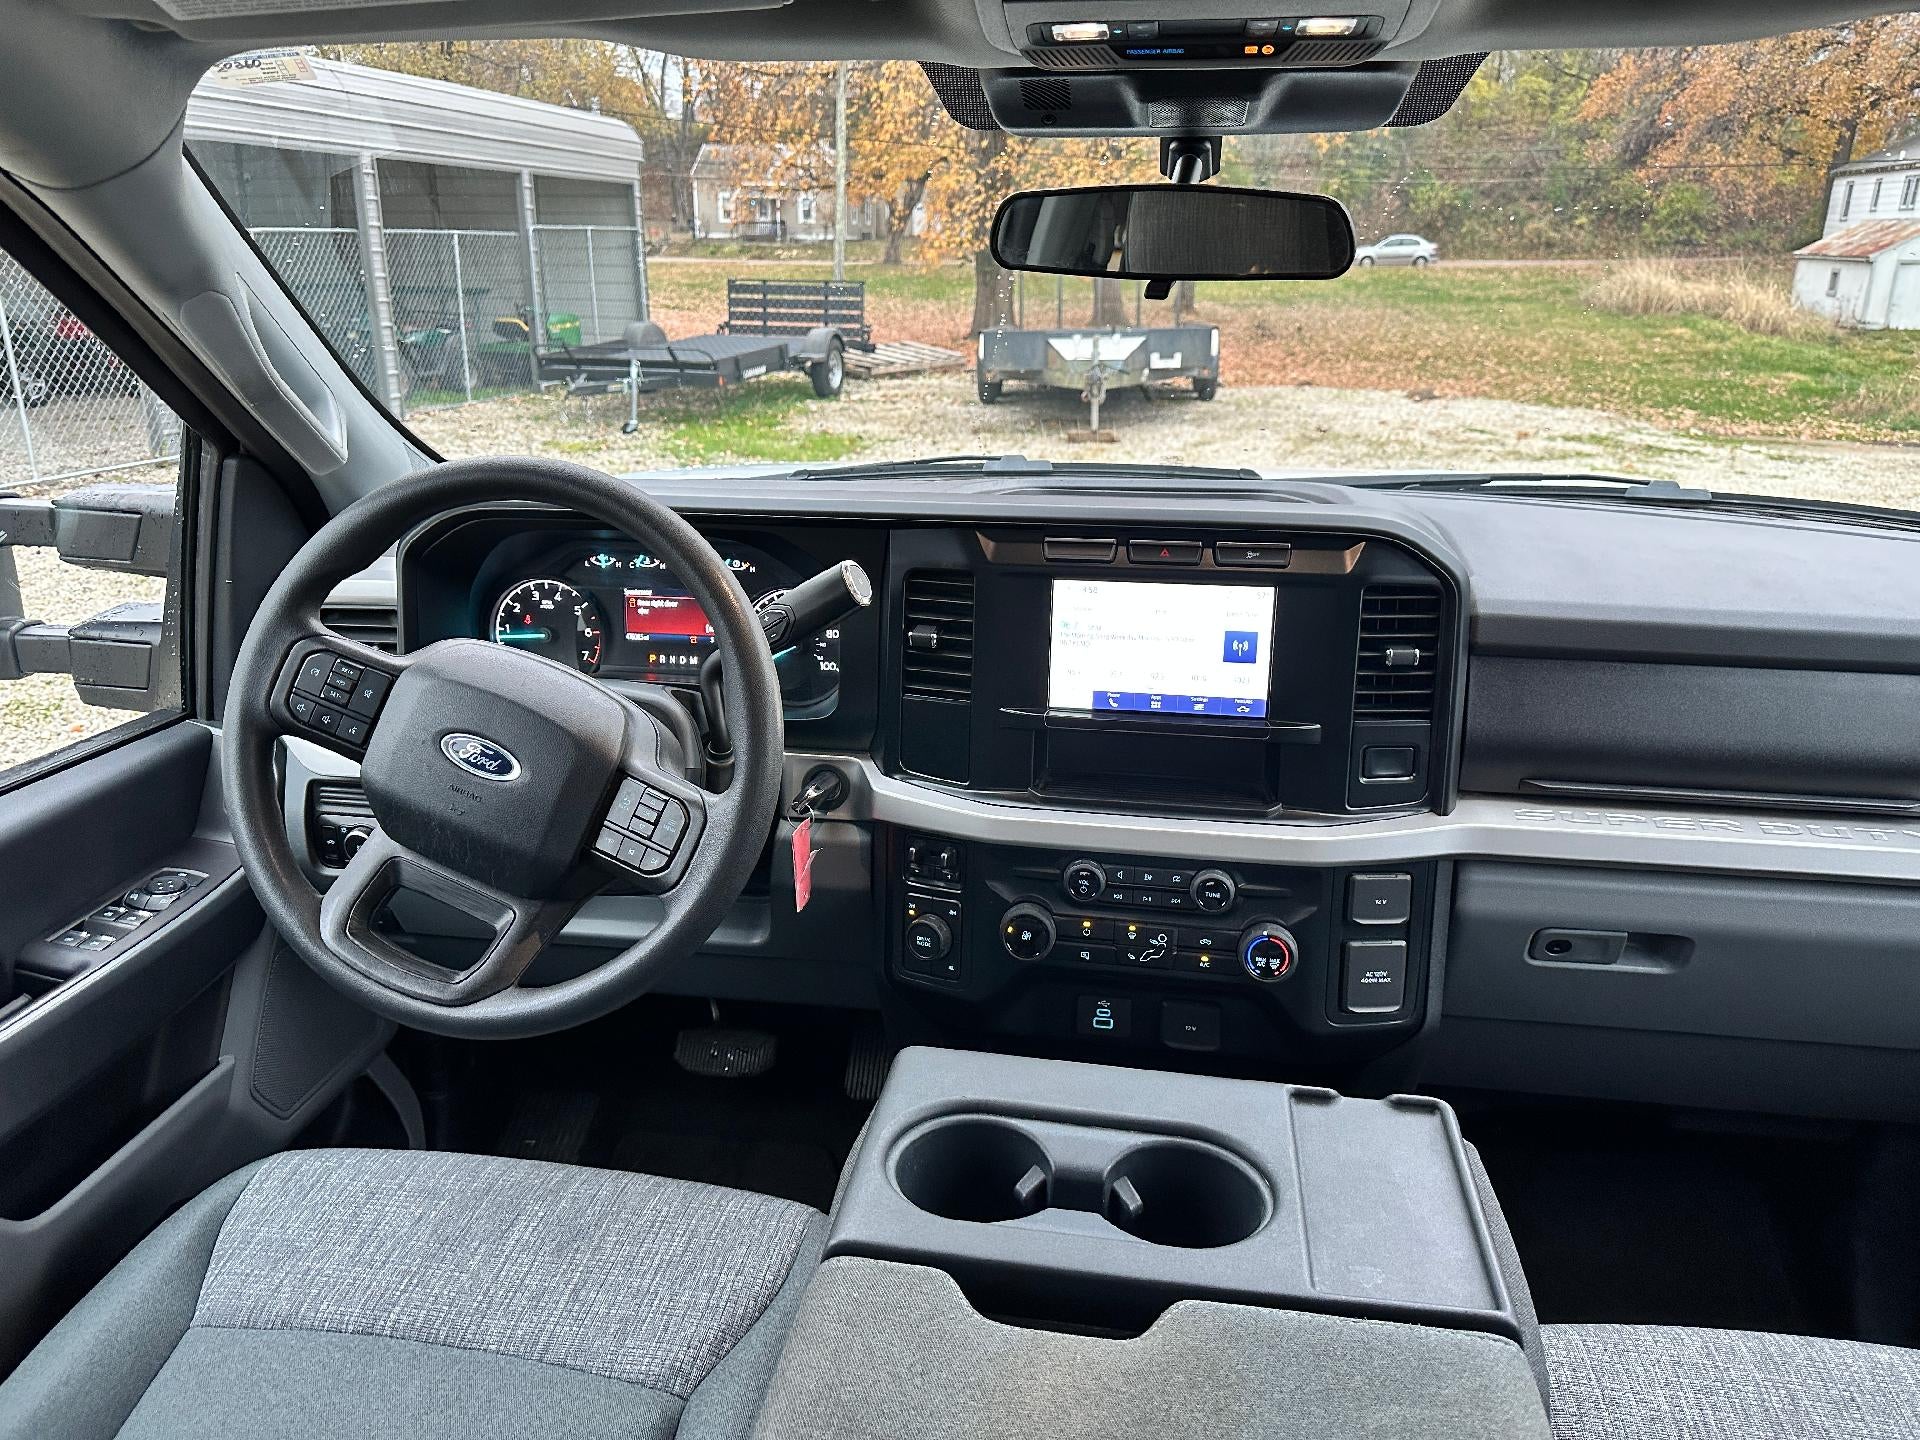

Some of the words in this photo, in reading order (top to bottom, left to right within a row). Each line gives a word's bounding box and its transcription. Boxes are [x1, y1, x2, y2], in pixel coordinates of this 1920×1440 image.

[532, 591, 540, 601] 3
[554, 592, 562, 601] 4
[513, 603, 521, 612] 2
[574, 605, 581, 616] 5
[505, 624, 510, 633] 1
[584, 628, 592, 637] 6
[825, 630, 840, 639] 80
[582, 651, 590, 660] 7
[649, 654, 657, 663] P
[659, 655, 666, 664] R
[669, 655, 676, 664] N
[680, 656, 687, 664] D
[689, 656, 698, 665] M
[820, 661, 837, 671] 100
[459, 742, 501, 771] Ford
[448, 783, 483, 803] AIRBAG
[1513, 808, 1745, 833] SUPER
[1205, 891, 1221, 899] TUNE
